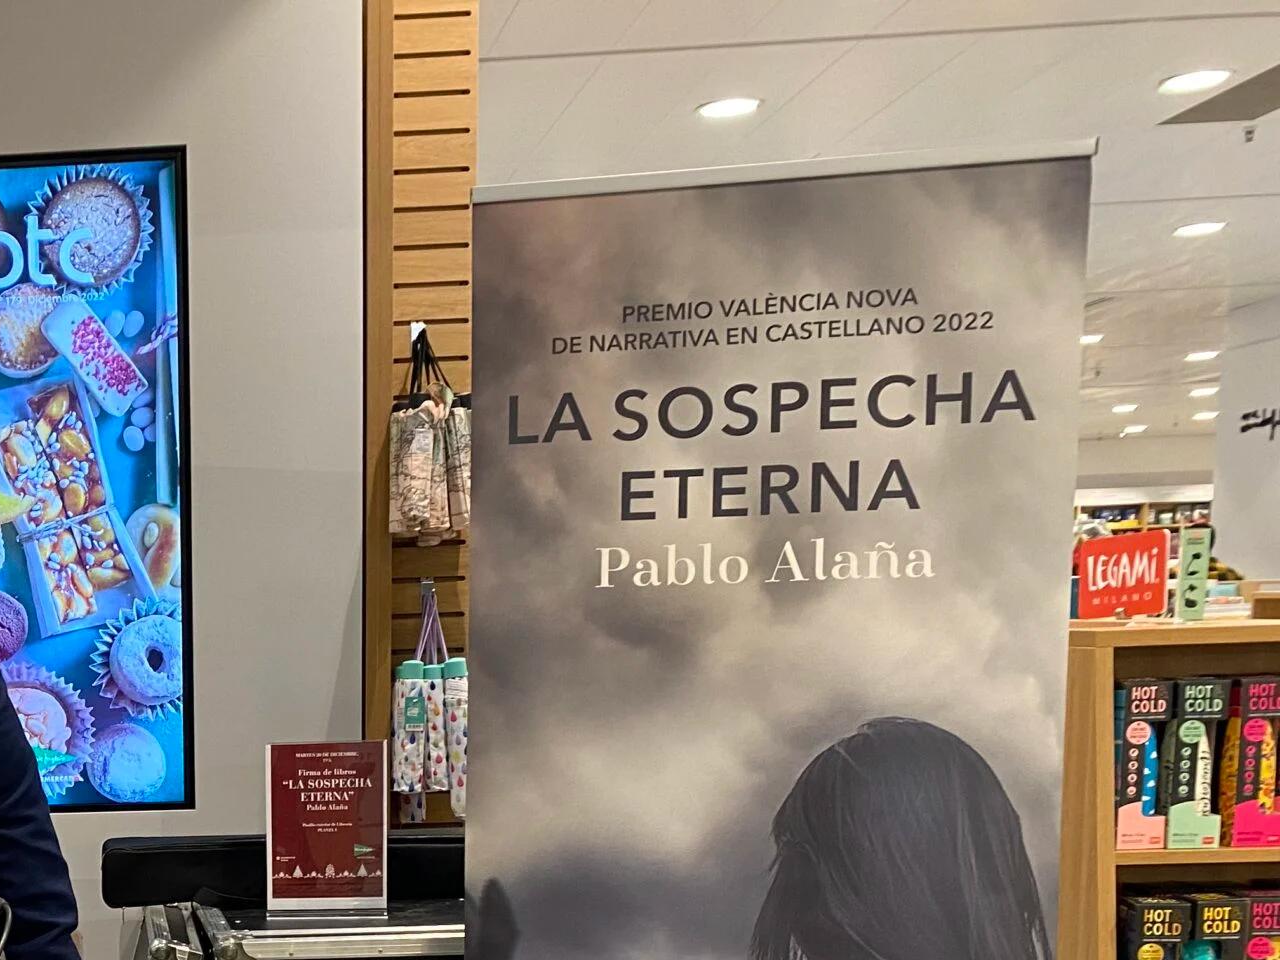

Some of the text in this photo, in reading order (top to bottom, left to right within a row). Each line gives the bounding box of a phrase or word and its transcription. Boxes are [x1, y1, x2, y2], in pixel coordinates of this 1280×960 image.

[80, 292, 105, 302] 2022
[622, 288, 918, 324] PREMIO VALÈNCIA NOVA
[552, 311, 995, 355] DE NARRATIVA EN CASTELLANO 2022
[508, 369, 1037, 445] LA SOSPECHA
[620, 458, 921, 521] ETERNA
[594, 537, 936, 589] Pablo Alaña
[1092, 591, 1152, 605] MILANO
[1131, 686, 1157, 699] HOT
[1185, 685, 1214, 699] HOT
[1249, 683, 1277, 697] HOT
[1131, 700, 1167, 714] COLD
[1185, 698, 1223, 712] COLD
[307, 777, 372, 789] SOSPECHA
[1143, 909, 1172, 923] HOT
[1203, 906, 1232, 920] HOT
[1253, 902, 1280, 916] HOT
[1143, 922, 1182, 936] COLD
[1203, 920, 1241, 934] COLD
[1253, 916, 1280, 929] COL
